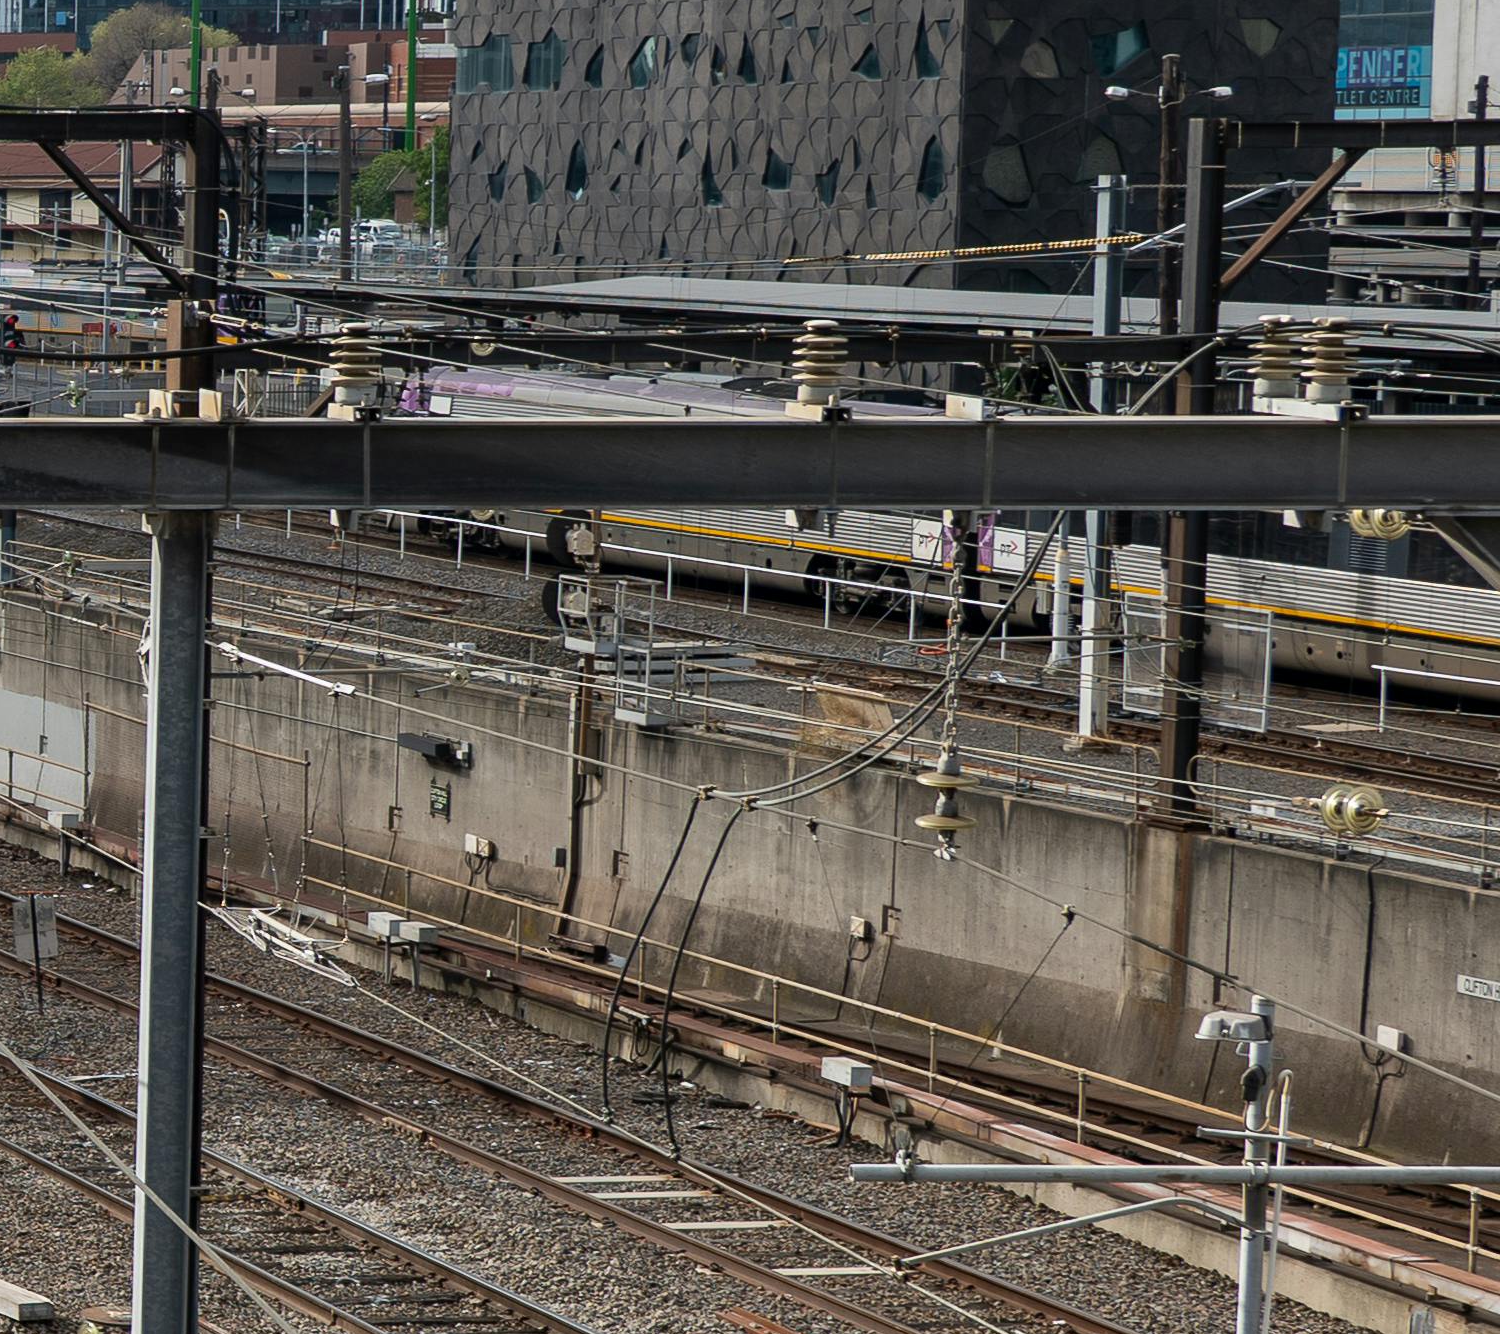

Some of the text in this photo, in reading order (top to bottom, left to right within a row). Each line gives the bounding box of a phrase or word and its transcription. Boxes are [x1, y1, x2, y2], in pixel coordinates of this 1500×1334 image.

[1336, 48, 1421, 83] PENCER
[1336, 88, 1418, 104] TLET CENTRE
